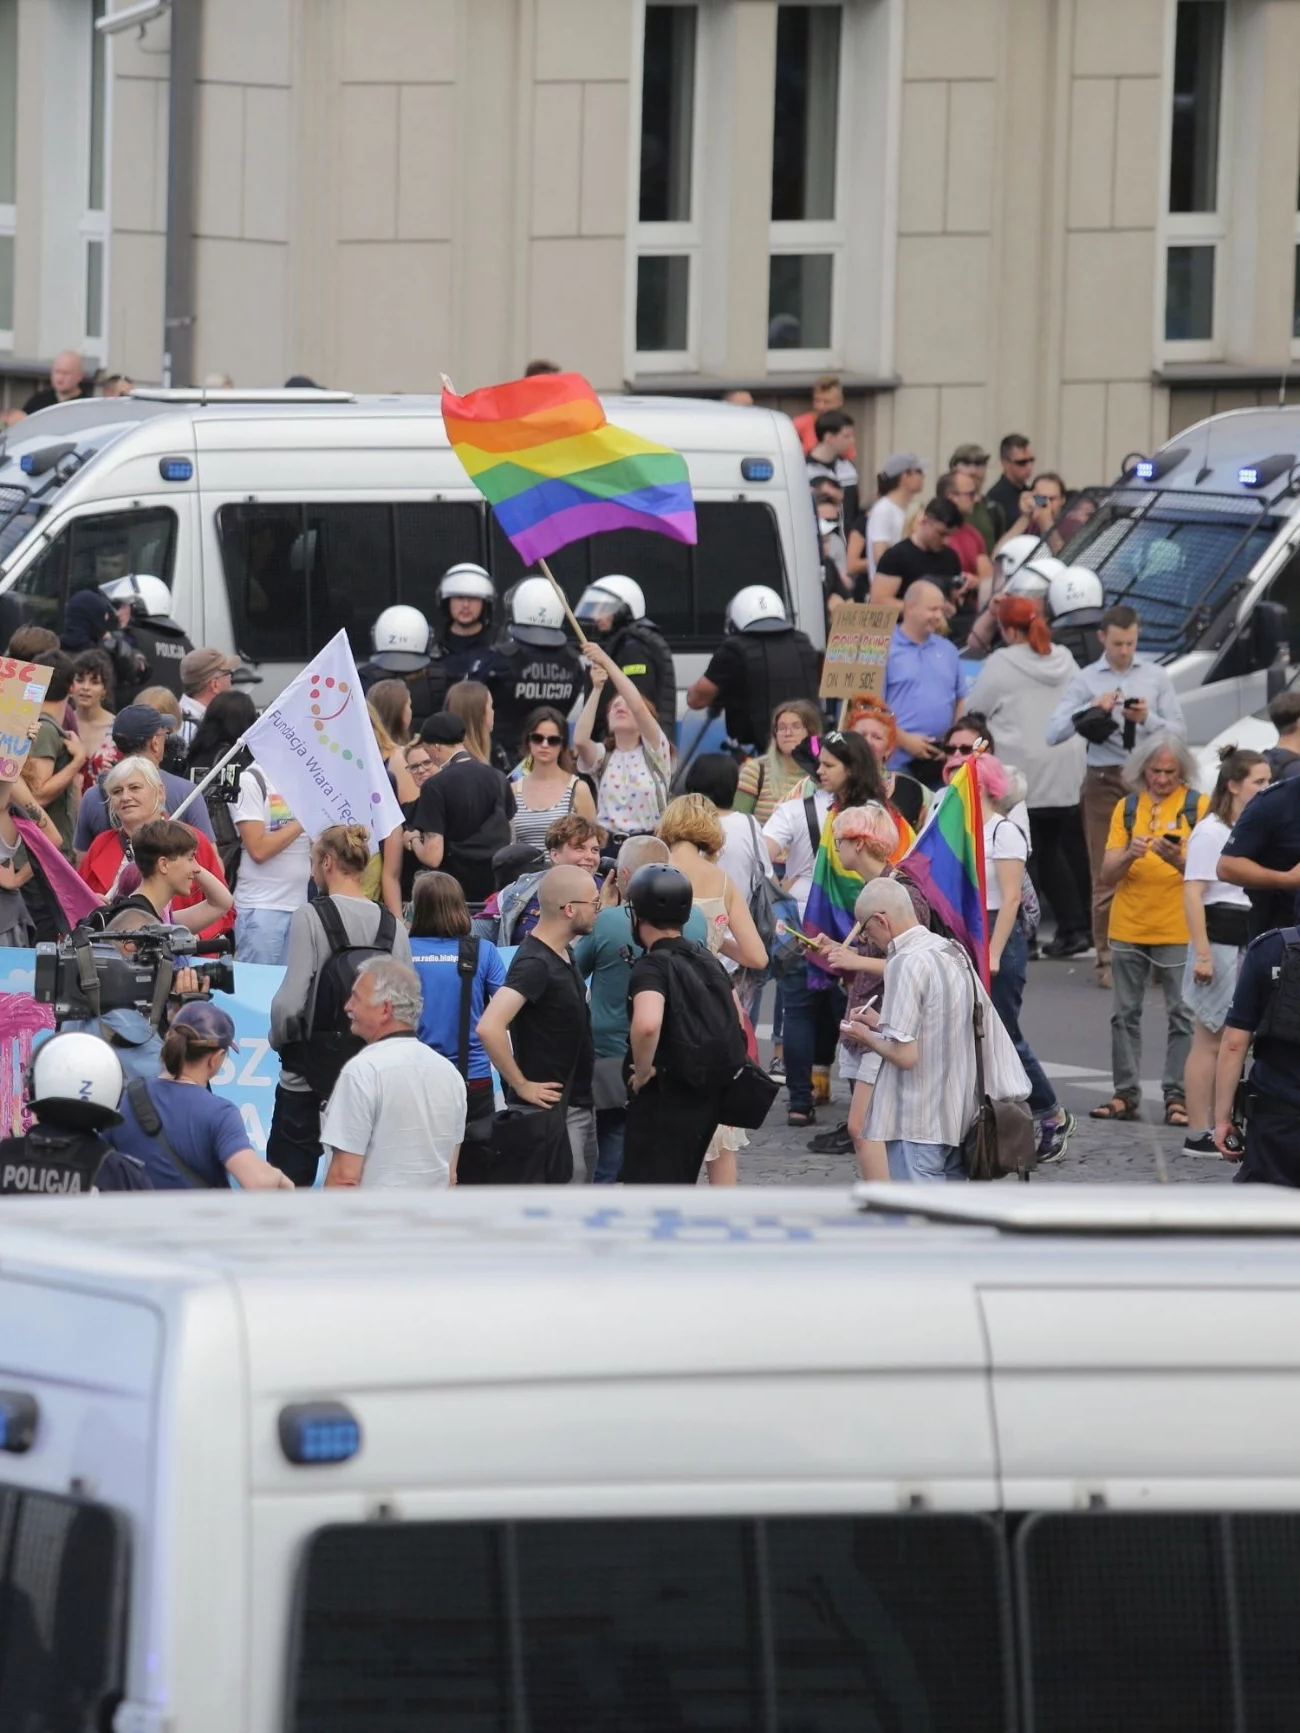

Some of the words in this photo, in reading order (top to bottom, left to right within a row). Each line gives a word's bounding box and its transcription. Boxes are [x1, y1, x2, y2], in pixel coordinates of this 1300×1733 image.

[155, 641, 186, 660] POLICJA
[827, 672, 839, 688] ON
[844, 672, 855, 688] MY
[514, 682, 573, 699] POLICJA
[268, 709, 307, 757] Fundacja
[305, 756, 334, 796] Wiara
[331, 793, 342, 803] i
[79, 1080, 93, 1095] Z
[2, 1164, 82, 1195] POLICJA
